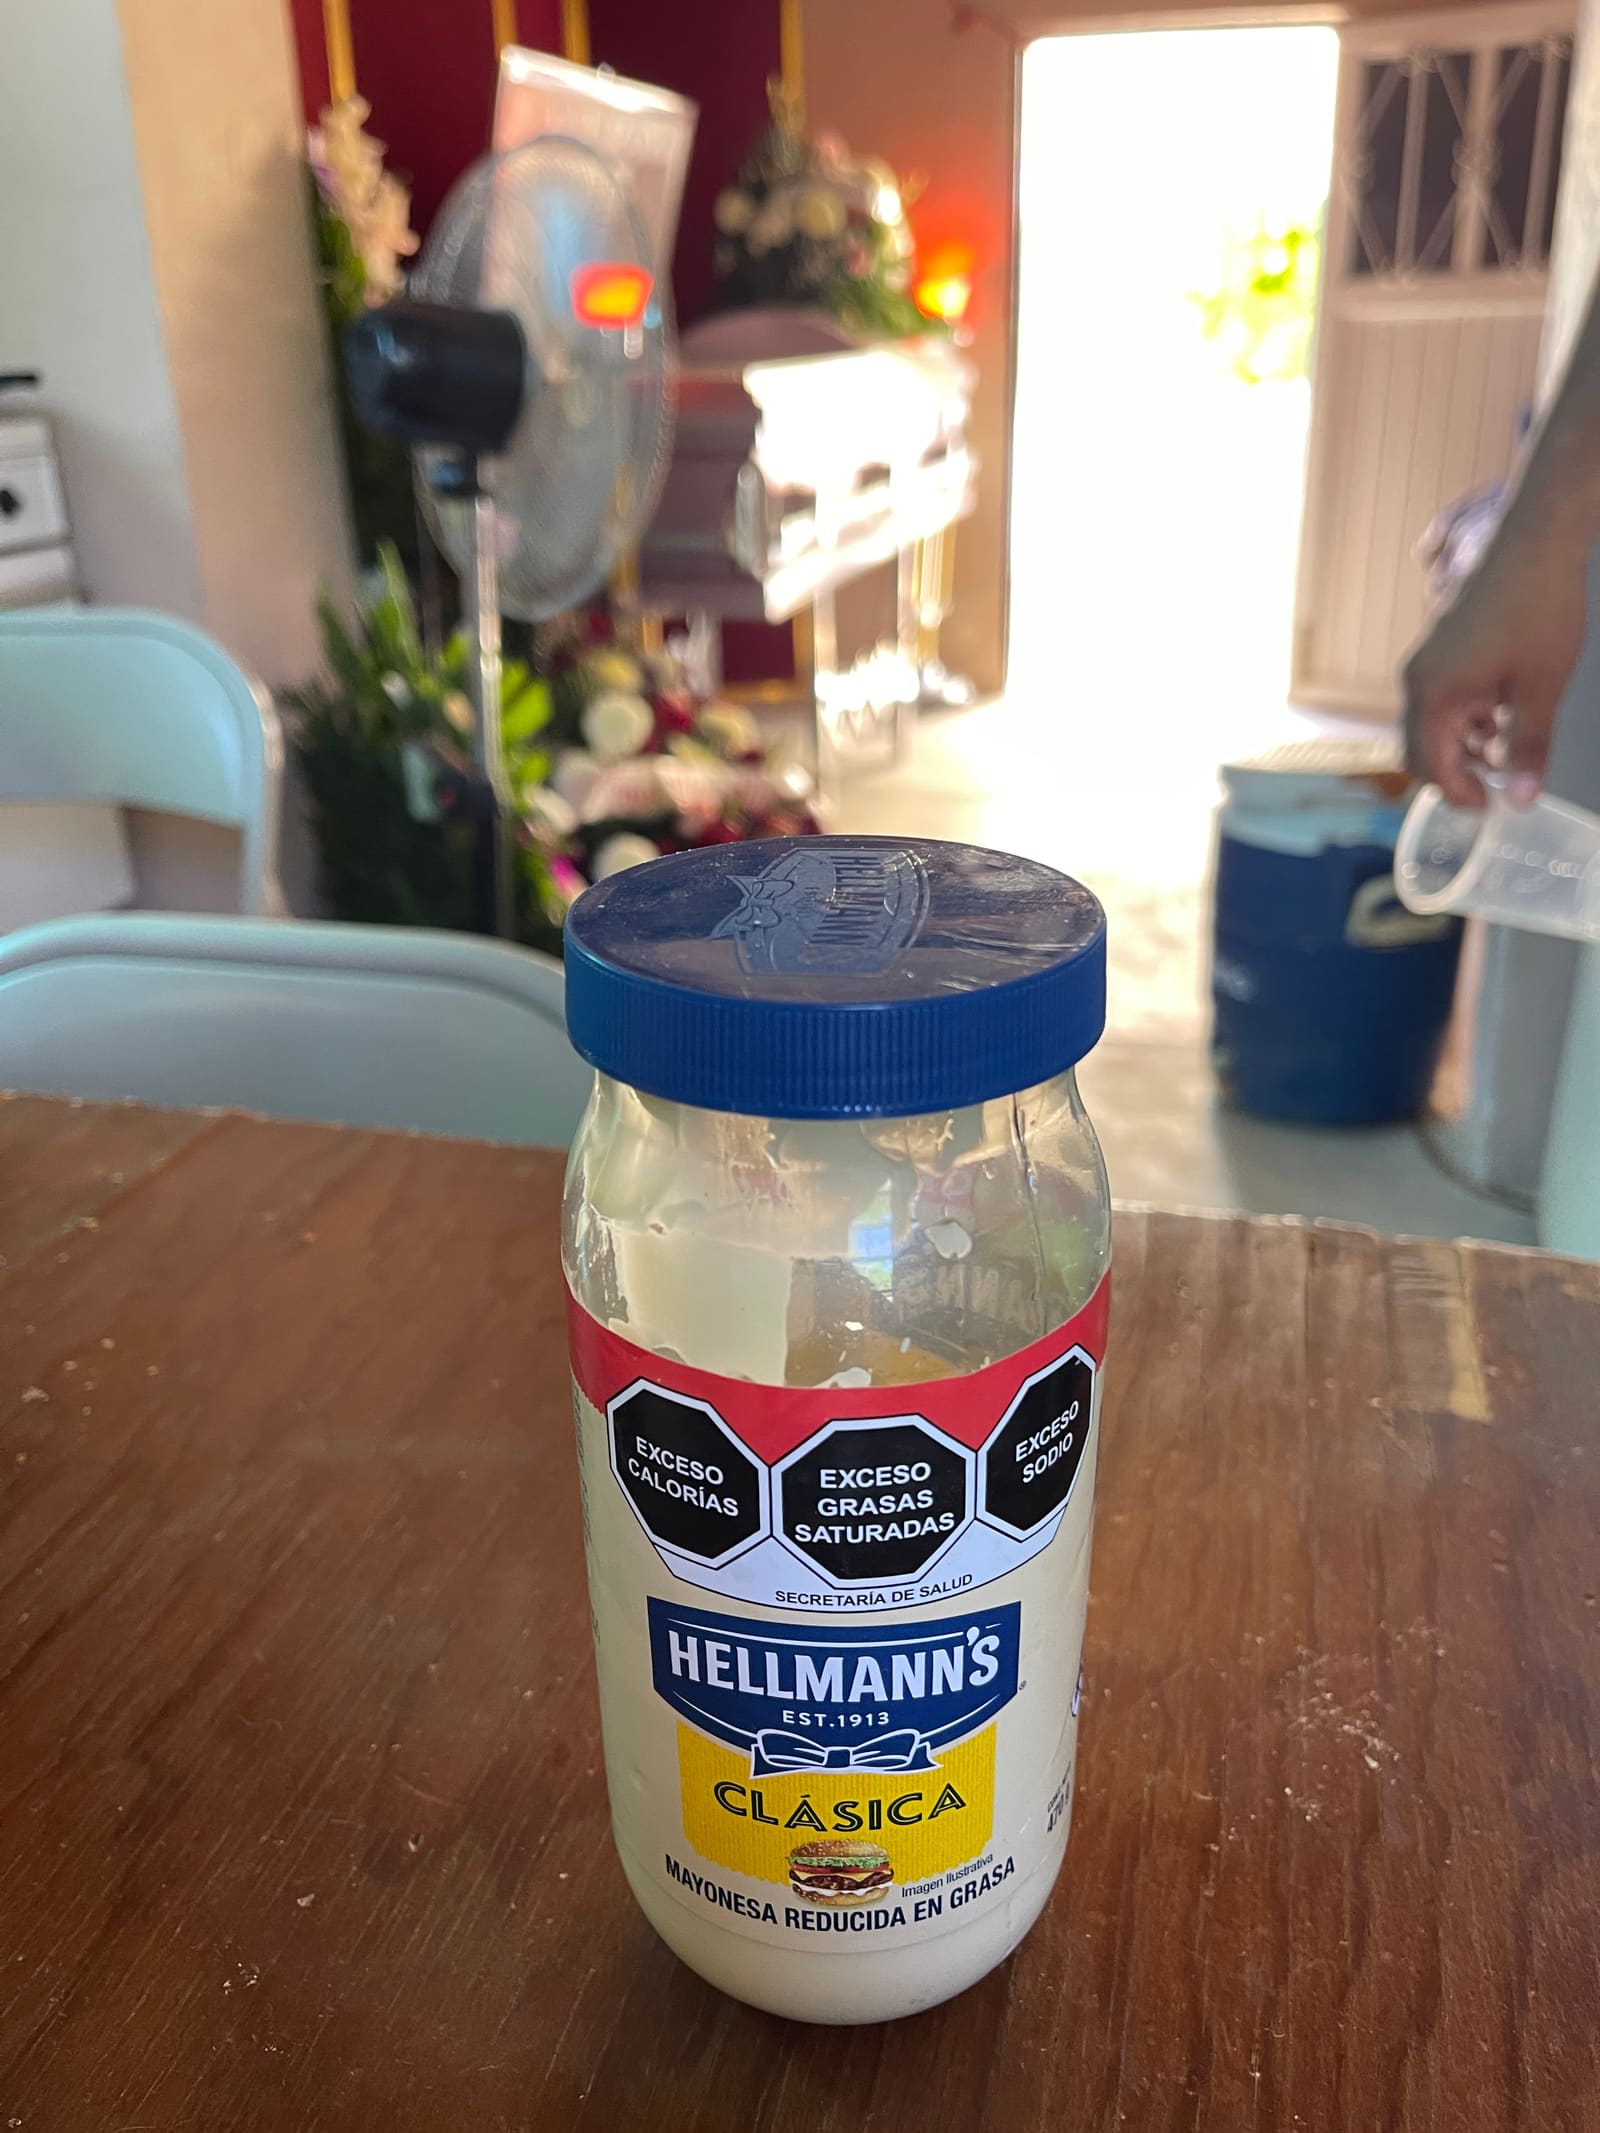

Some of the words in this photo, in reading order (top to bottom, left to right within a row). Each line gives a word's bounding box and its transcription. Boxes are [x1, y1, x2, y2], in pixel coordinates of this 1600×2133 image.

[1016, 1401, 1079, 1463] EXCESO
[636, 1436, 724, 1485] EXCESO
[820, 1462, 931, 1489] EXCESO
[1022, 1433, 1073, 1484] SODIO
[628, 1458, 739, 1517] CALORÍAS
[817, 1489, 933, 1517] GRASAS
[795, 1512, 955, 1544] SATURADAS
[775, 1590, 886, 1607] SECRETARÍA
[891, 1589, 914, 1602] DE
[919, 1573, 973, 1597] SALUD
[668, 1626, 1000, 1702] HELLMANN'S
[713, 1781, 966, 1831] CLÁSICA
[665, 1853, 778, 1926] MAYONESA
[785, 1906, 906, 1932] REDUCIDA
[913, 1894, 943, 1922] EN
[949, 1855, 1015, 1910] GRASA
[901, 1879, 944, 1898] Imagen
[946, 1853, 994, 1884] Ilustrativa
